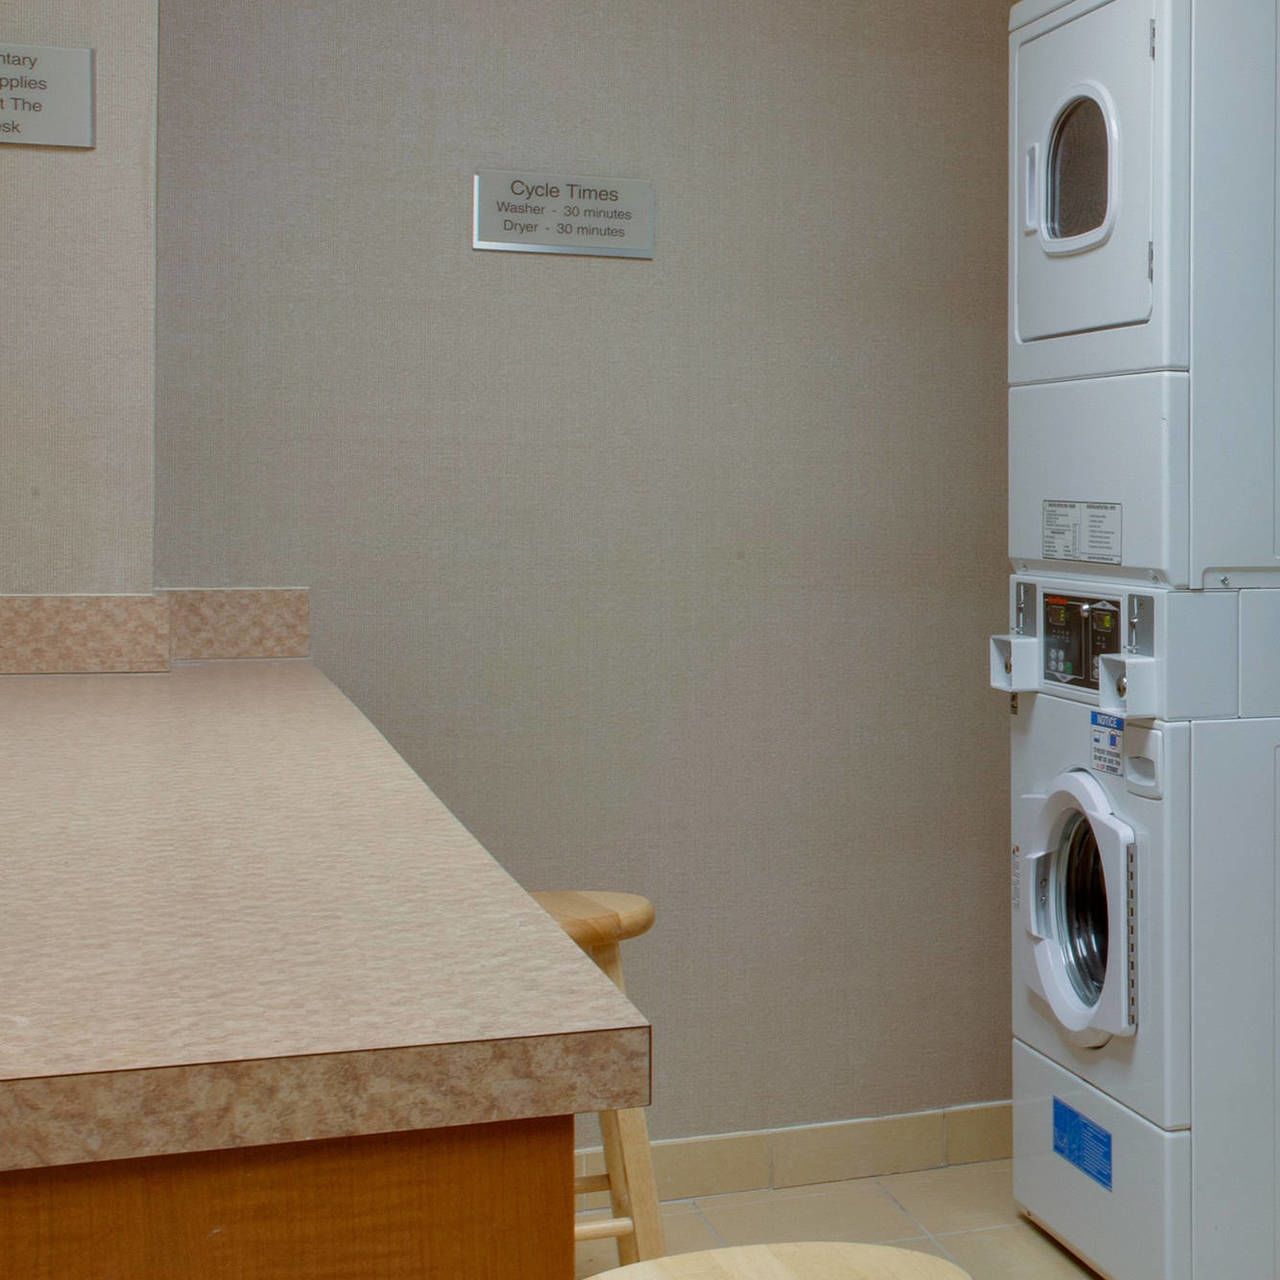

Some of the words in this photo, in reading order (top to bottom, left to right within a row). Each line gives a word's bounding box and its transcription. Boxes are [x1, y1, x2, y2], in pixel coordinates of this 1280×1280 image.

[10, 97, 43, 112] The
[0, 120, 21, 133] sk
[510, 179, 560, 200] Cycle
[565, 183, 619, 202] Times
[496, 199, 546, 215] Washer
[563, 205, 580, 217] 30
[583, 207, 633, 221] minutes
[503, 219, 538, 234] Dryer
[556, 223, 573, 234] 30
[576, 225, 626, 238] minutes
